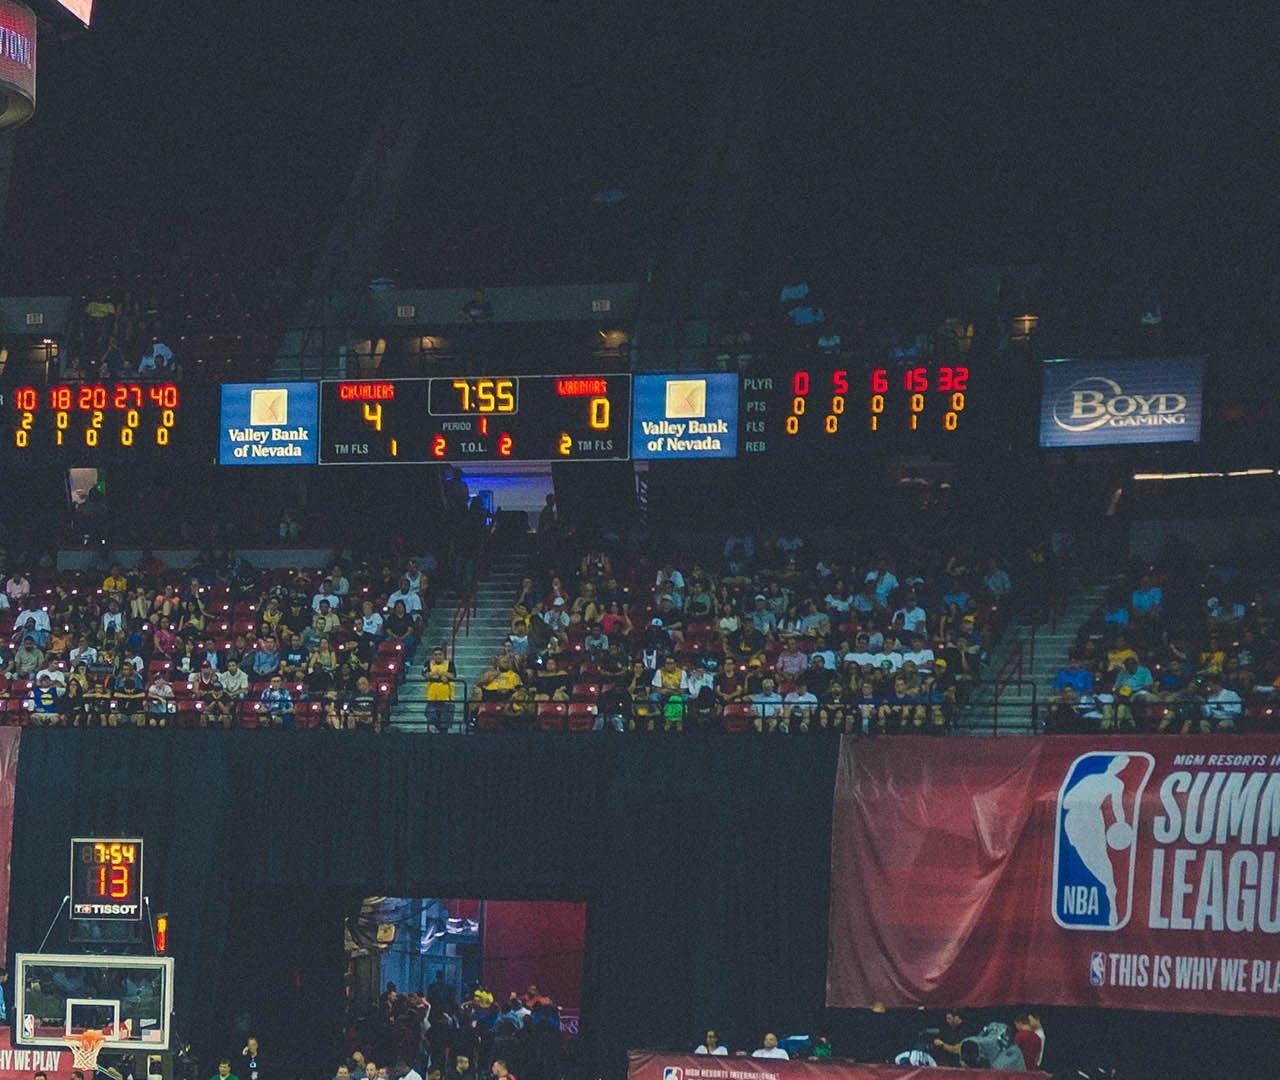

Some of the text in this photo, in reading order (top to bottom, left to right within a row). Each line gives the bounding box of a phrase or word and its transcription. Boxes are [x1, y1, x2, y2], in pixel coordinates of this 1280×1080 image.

[744, 367, 969, 395] PLYR 0 5 6 15 32
[16, 390, 36, 410] 10
[52, 388, 71, 409] 18
[79, 388, 106, 409] 20
[114, 386, 141, 409] 27
[150, 386, 177, 408] 40
[453, 381, 514, 412] 7:55
[746, 393, 965, 415] PTS 0 0 0 0 0
[1070, 390, 1187, 420] BOYD
[21, 412, 33, 430] 2
[56, 411, 68, 429] 0
[92, 411, 104, 428] 2
[127, 410, 139, 428] 0
[162, 409, 174, 427] 0
[363, 403, 382, 431] 4
[590, 398, 610, 429] 0
[746, 421, 766, 432] FLS
[786, 416, 799, 435] 0
[825, 415, 838, 434] 0
[944, 411, 957, 431] 0
[1109, 413, 1186, 427] GAMING
[15, 430, 28, 447] 0
[56, 430, 63, 445] 1
[86, 429, 98, 446] 0
[121, 428, 133, 446] 0
[156, 427, 169, 445] 0
[228, 427, 309, 444] Valley Bank
[442, 421, 472, 432] PERIOD
[641, 418, 729, 437] Valley Bank
[234, 443, 302, 457] of Nevada
[334, 444, 350, 455] TM
[351, 443, 369, 455] FLS
[433, 437, 446, 456] 2
[500, 437, 512, 456] 2
[560, 435, 613, 455] 2 TM FLS
[647, 436, 722, 451] of Nevada
[745, 440, 766, 453] REB
[1173, 754, 1205, 765] MGM
[1207, 755, 1268, 767] RESORTS
[94, 843, 136, 864] 7:54
[98, 865, 130, 898] 13
[92, 903, 138, 915] TISSOT
[1063, 884, 1100, 917] NBA
[1109, 953, 1150, 987] THIS
[1153, 955, 1172, 988] IS
[1174, 956, 1218, 992] WHY
[1220, 958, 1249, 992] WE
[14, 1049, 33, 1072] WE
[33, 1049, 61, 1072] PLAY
